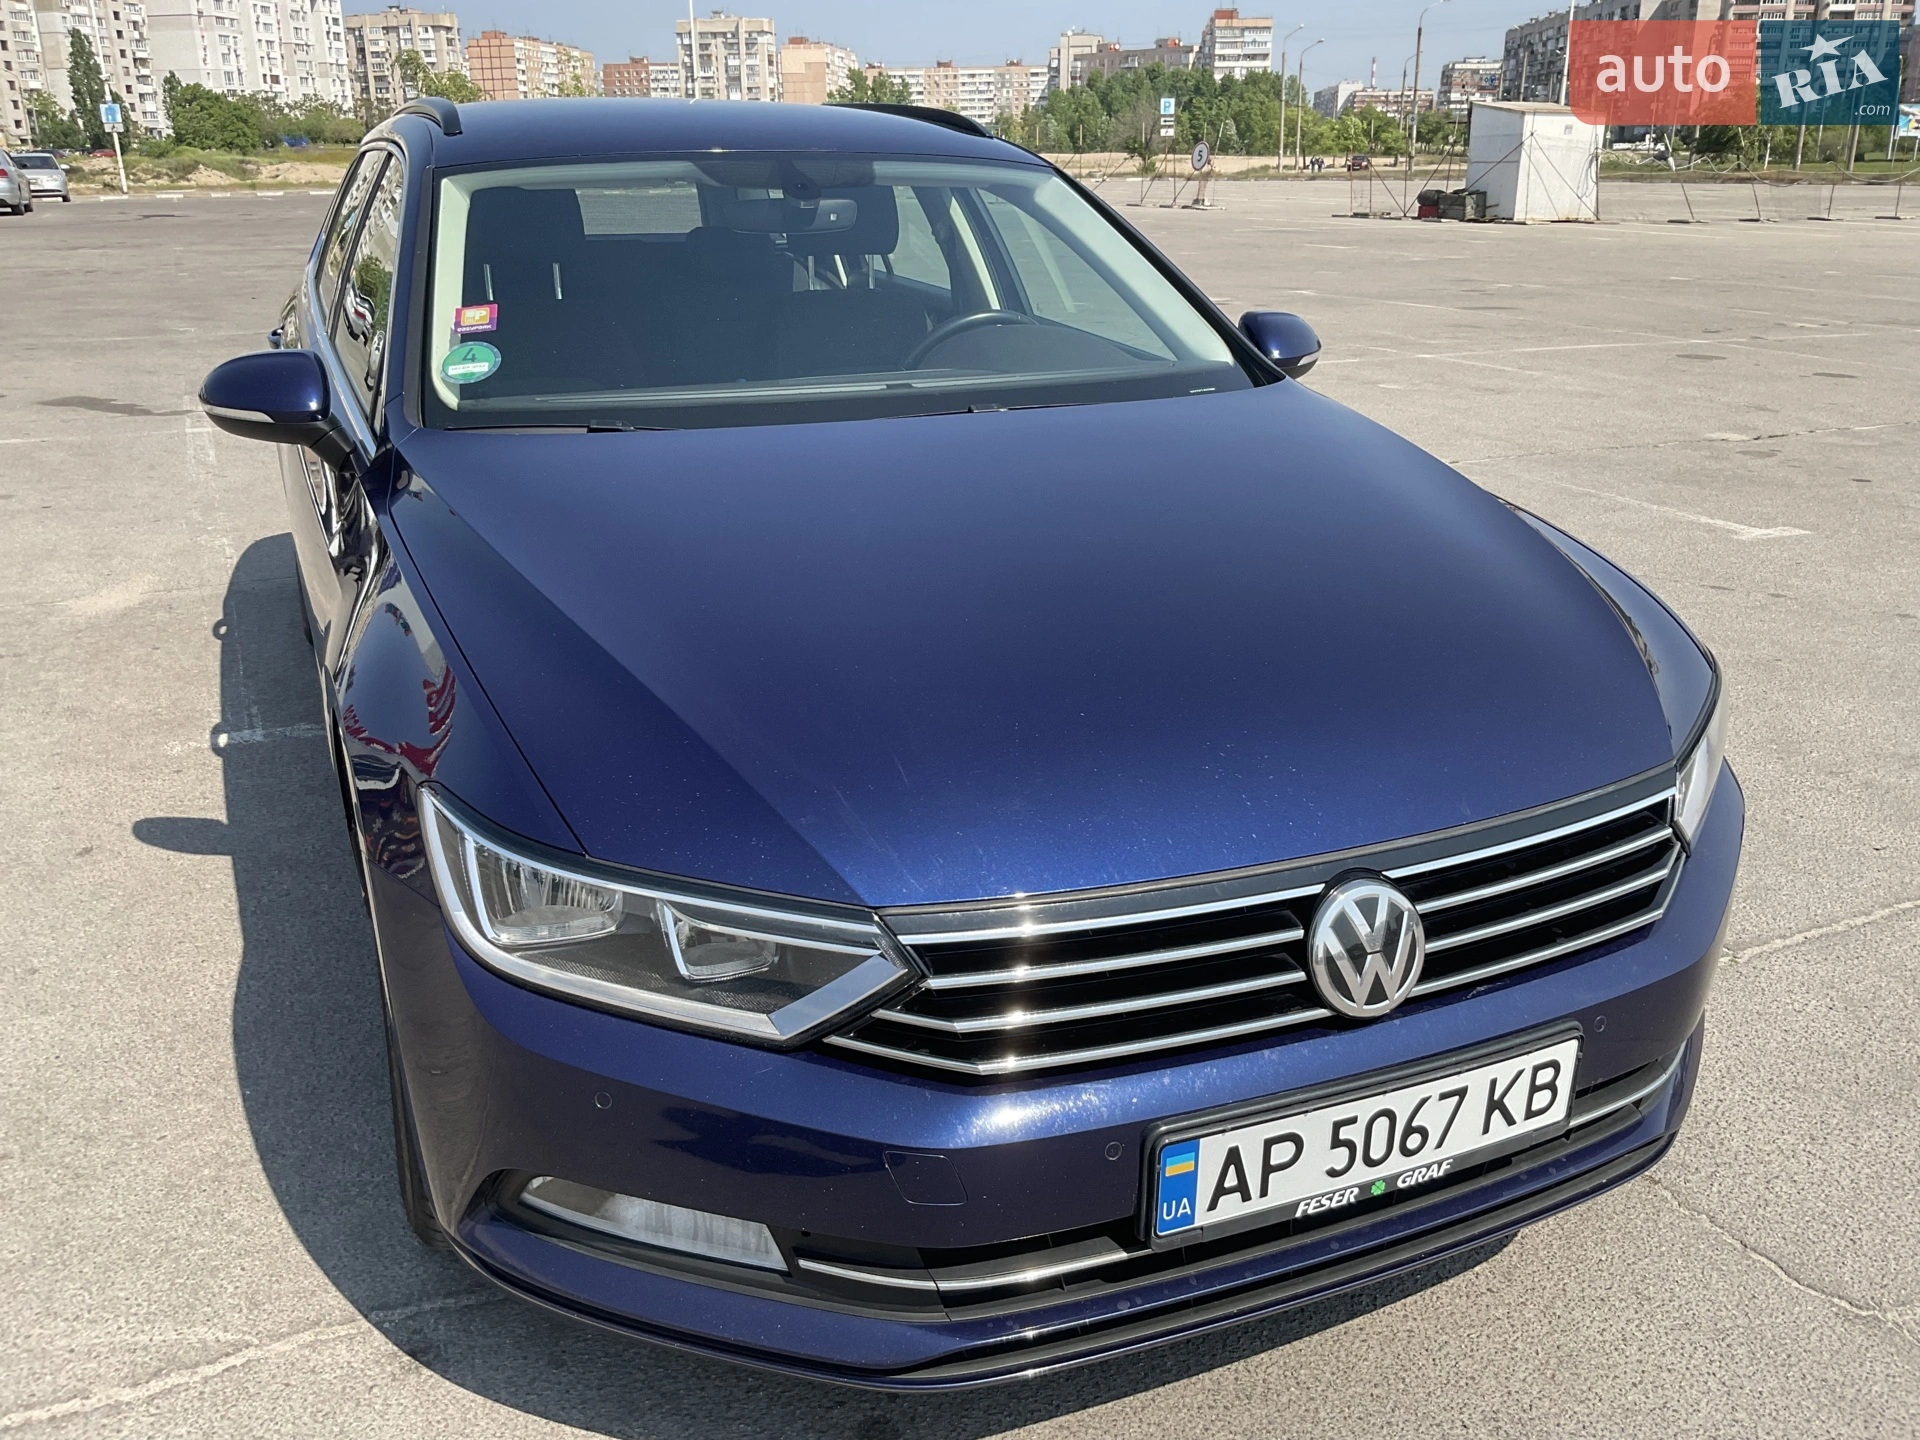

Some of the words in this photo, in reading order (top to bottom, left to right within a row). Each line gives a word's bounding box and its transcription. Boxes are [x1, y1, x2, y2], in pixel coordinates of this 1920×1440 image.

[1197, 150, 1203, 162] 5
[462, 347, 477, 363] 4
[1313, 885, 1421, 1014] VW
[1206, 1131, 1304, 1212] AP
[1324, 1085, 1469, 1178] 5067
[1481, 1058, 1562, 1136] KB
[1162, 1197, 1192, 1220] UA
[1295, 1187, 1360, 1218] FESER
[1396, 1158, 1454, 1188] GRAF
